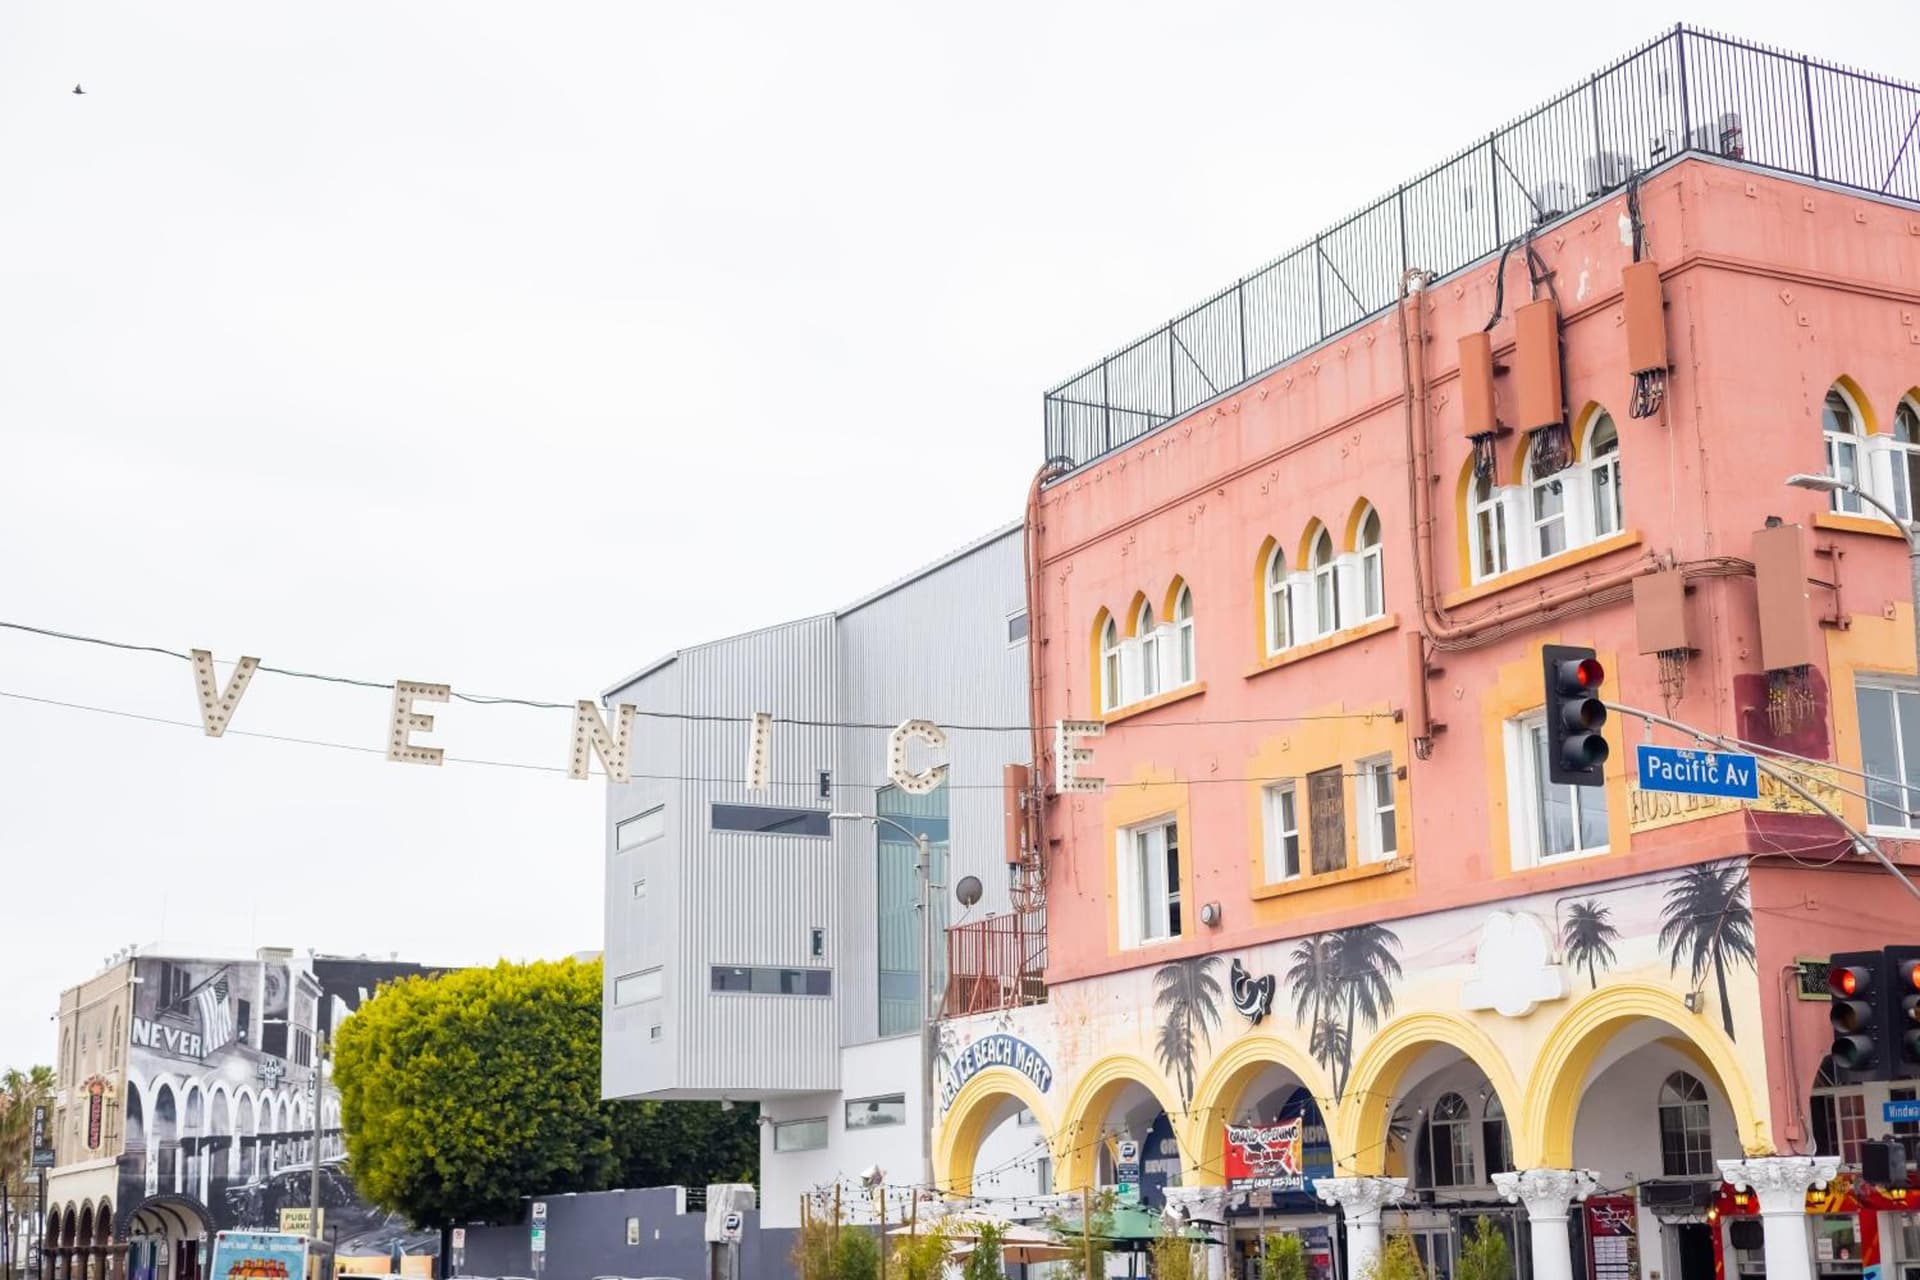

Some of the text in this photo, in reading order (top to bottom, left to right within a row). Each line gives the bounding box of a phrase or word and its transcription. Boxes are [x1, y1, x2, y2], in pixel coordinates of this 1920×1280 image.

[190, 648, 1105, 795] VENICE
[1648, 755, 1719, 784] Pacific
[1725, 763, 1749, 787] Av
[973, 1038, 1012, 1065] BEACH
[1015, 1043, 1051, 1093] MART
[35, 1108, 44, 1149] BAR
